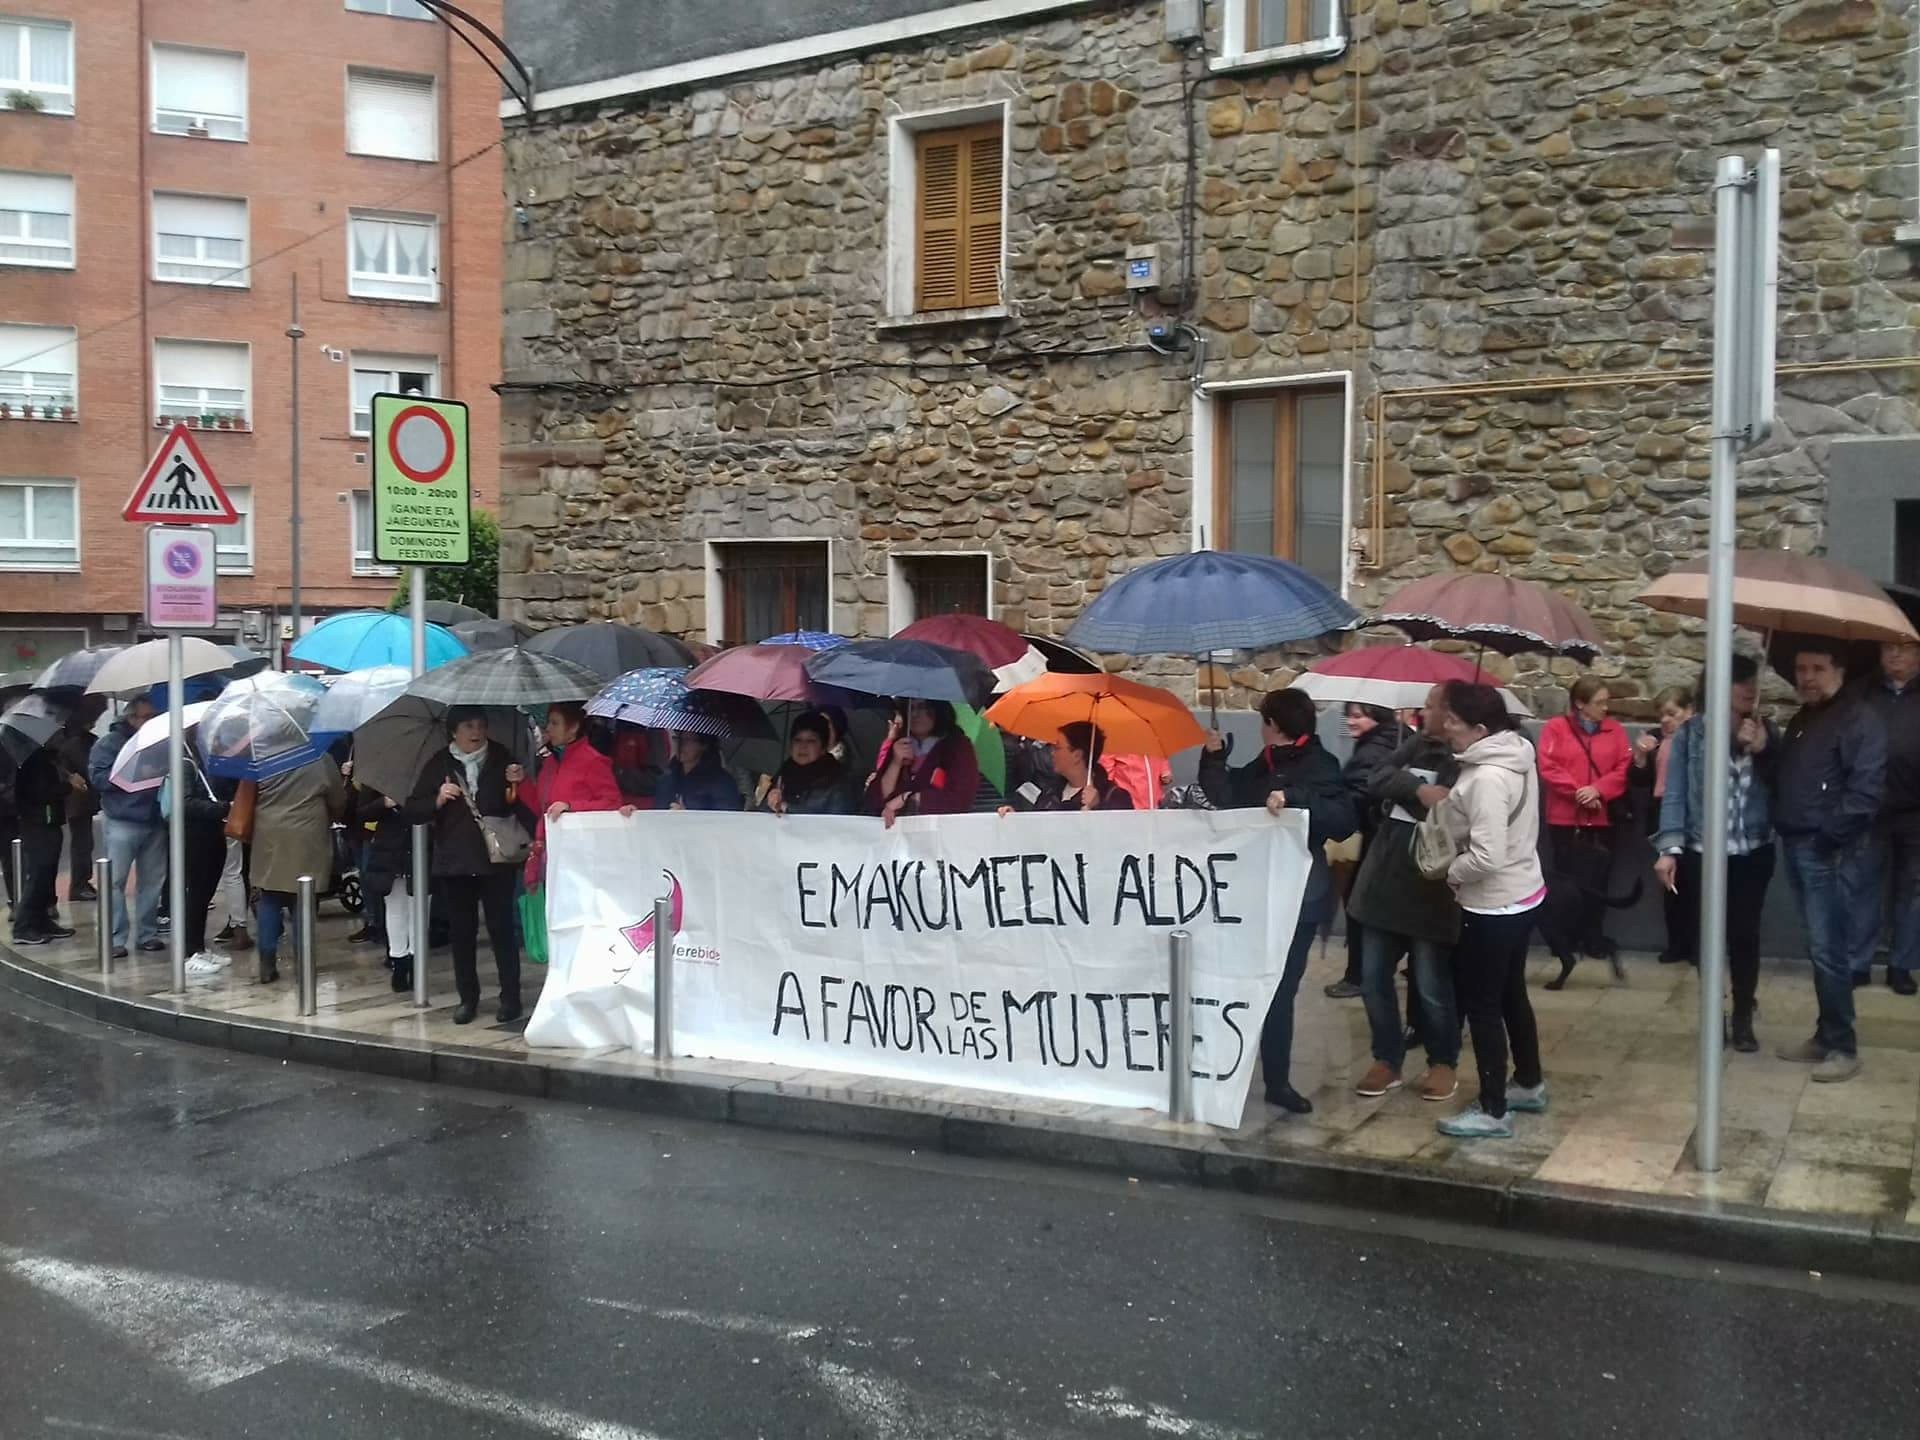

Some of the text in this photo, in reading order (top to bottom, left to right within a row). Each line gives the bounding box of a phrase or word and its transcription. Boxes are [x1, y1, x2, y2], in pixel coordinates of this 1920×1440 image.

[386, 485, 417, 496] 10:00
[428, 488, 458, 499] 20:00
[391, 504, 455, 516] IGANDE ETA
[386, 516, 460, 529] JAIEGUNETAN
[390, 536, 457, 548] DOMINGOS Y
[398, 548, 450, 560] FESTIVOS
[797, 852, 1242, 932] EMAKUMEEN ALDE
[772, 971, 810, 1040] A
[820, 976, 943, 1054] FAVOR
[950, 991, 992, 1024] DE
[948, 1025, 998, 1060] LAS
